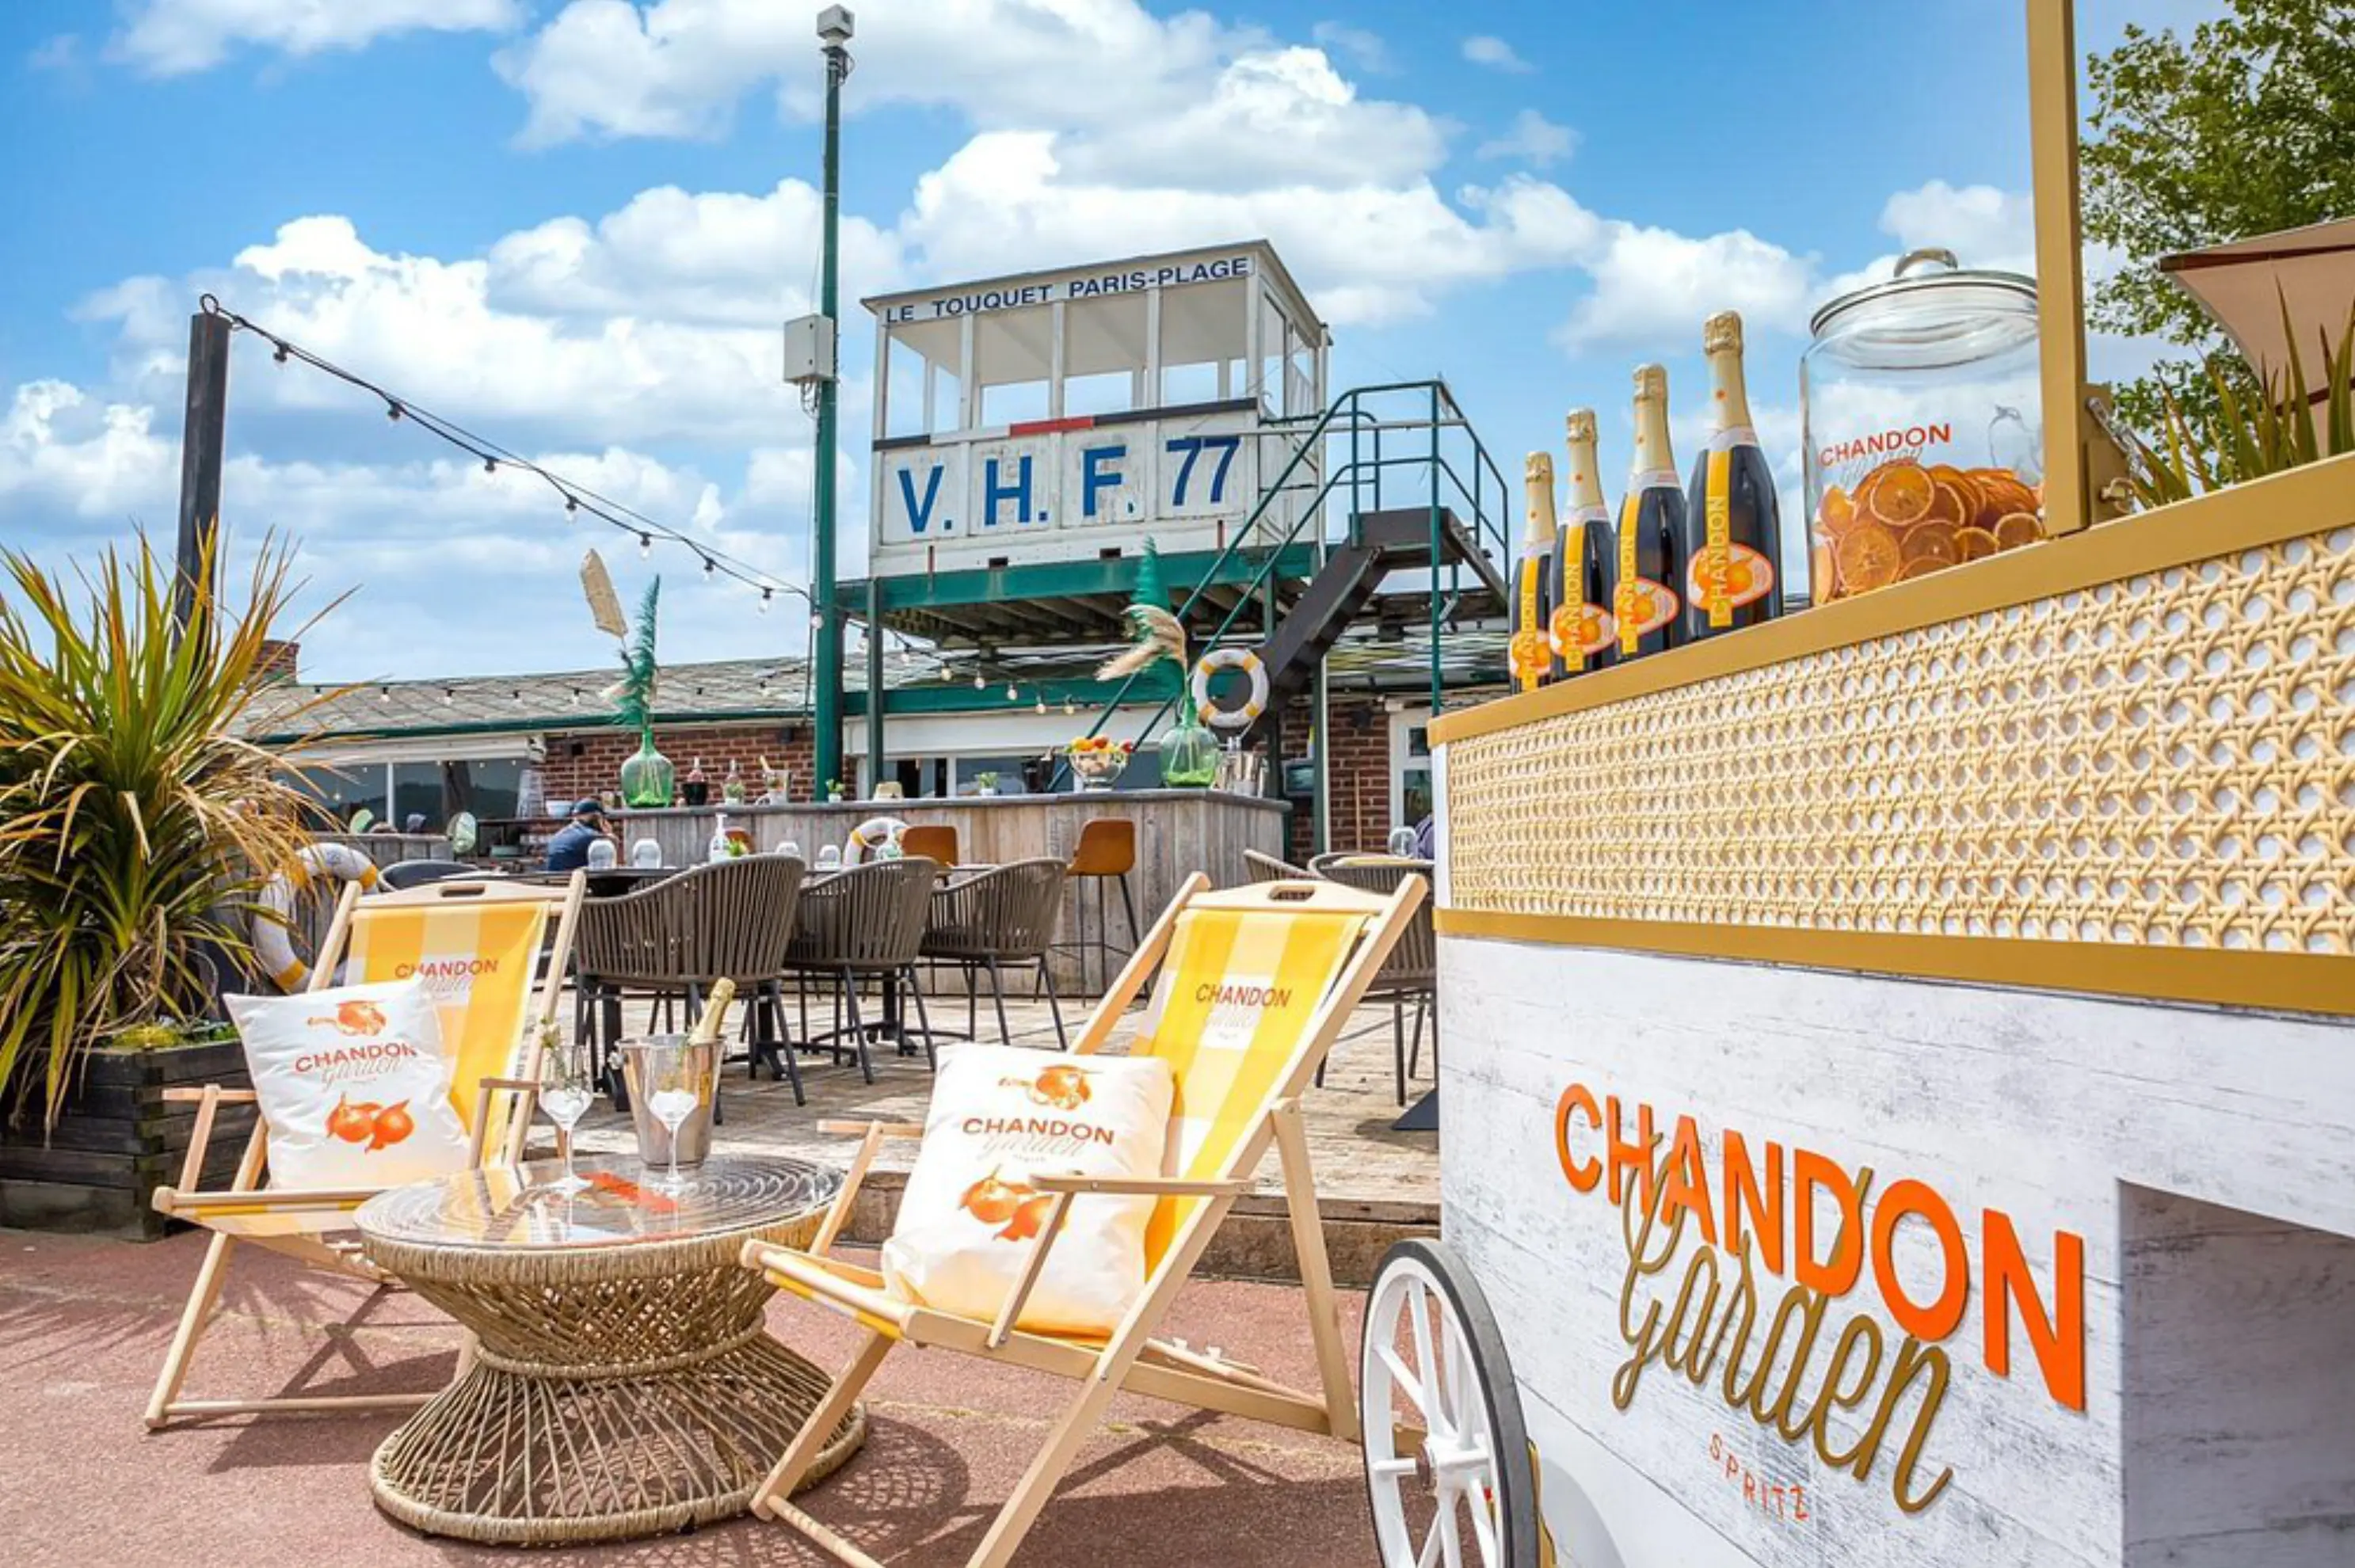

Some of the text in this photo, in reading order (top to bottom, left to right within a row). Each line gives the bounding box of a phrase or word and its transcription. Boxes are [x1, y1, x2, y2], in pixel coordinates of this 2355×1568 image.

[886, 257, 1249, 324] LE TOUQUET PARIS-PLAGE
[1166, 436, 1240, 508] 77
[1819, 422, 1951, 466] CHANDON
[1621, 536, 1635, 646] CHANDON
[1708, 496, 1729, 618] CHANDON
[1564, 564, 1582, 664] CHANDON
[1195, 983, 1293, 1008] CHANDON
[295, 1042, 417, 1072] CHANDON
[962, 1117, 1115, 1146] CHANDON
[1554, 1083, 2085, 1412] CHANDON
[1709, 1433, 1811, 1521] SPRITZ
